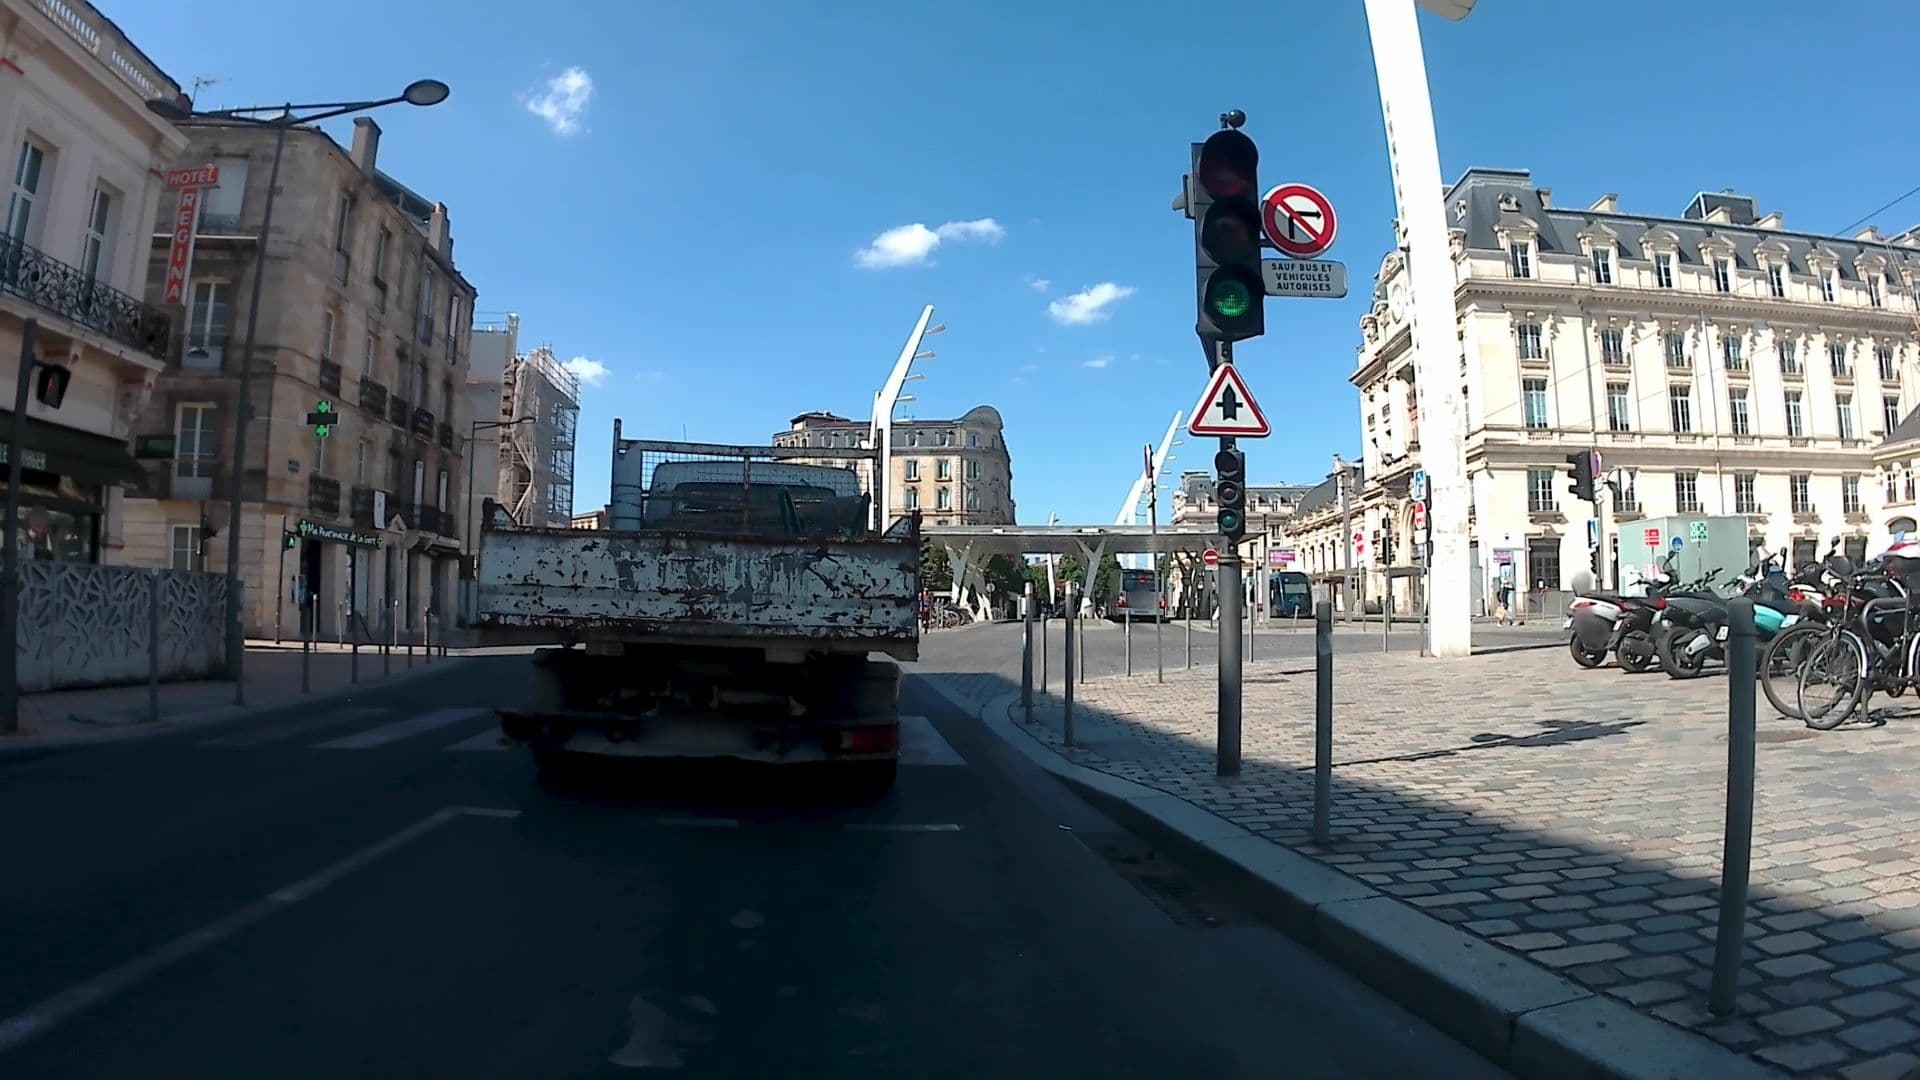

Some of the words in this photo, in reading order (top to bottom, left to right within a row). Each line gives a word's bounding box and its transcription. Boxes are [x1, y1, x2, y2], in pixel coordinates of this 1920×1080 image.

[169, 167, 216, 185] HOTEL
[168, 192, 195, 299] REGINA
[1272, 263, 1296, 272] SAUF
[1300, 263, 1318, 272] BUS
[1321, 264, 1332, 272] ET
[1275, 273, 1330, 282] VEHICULES
[1276, 283, 1331, 291] AUTORISES
